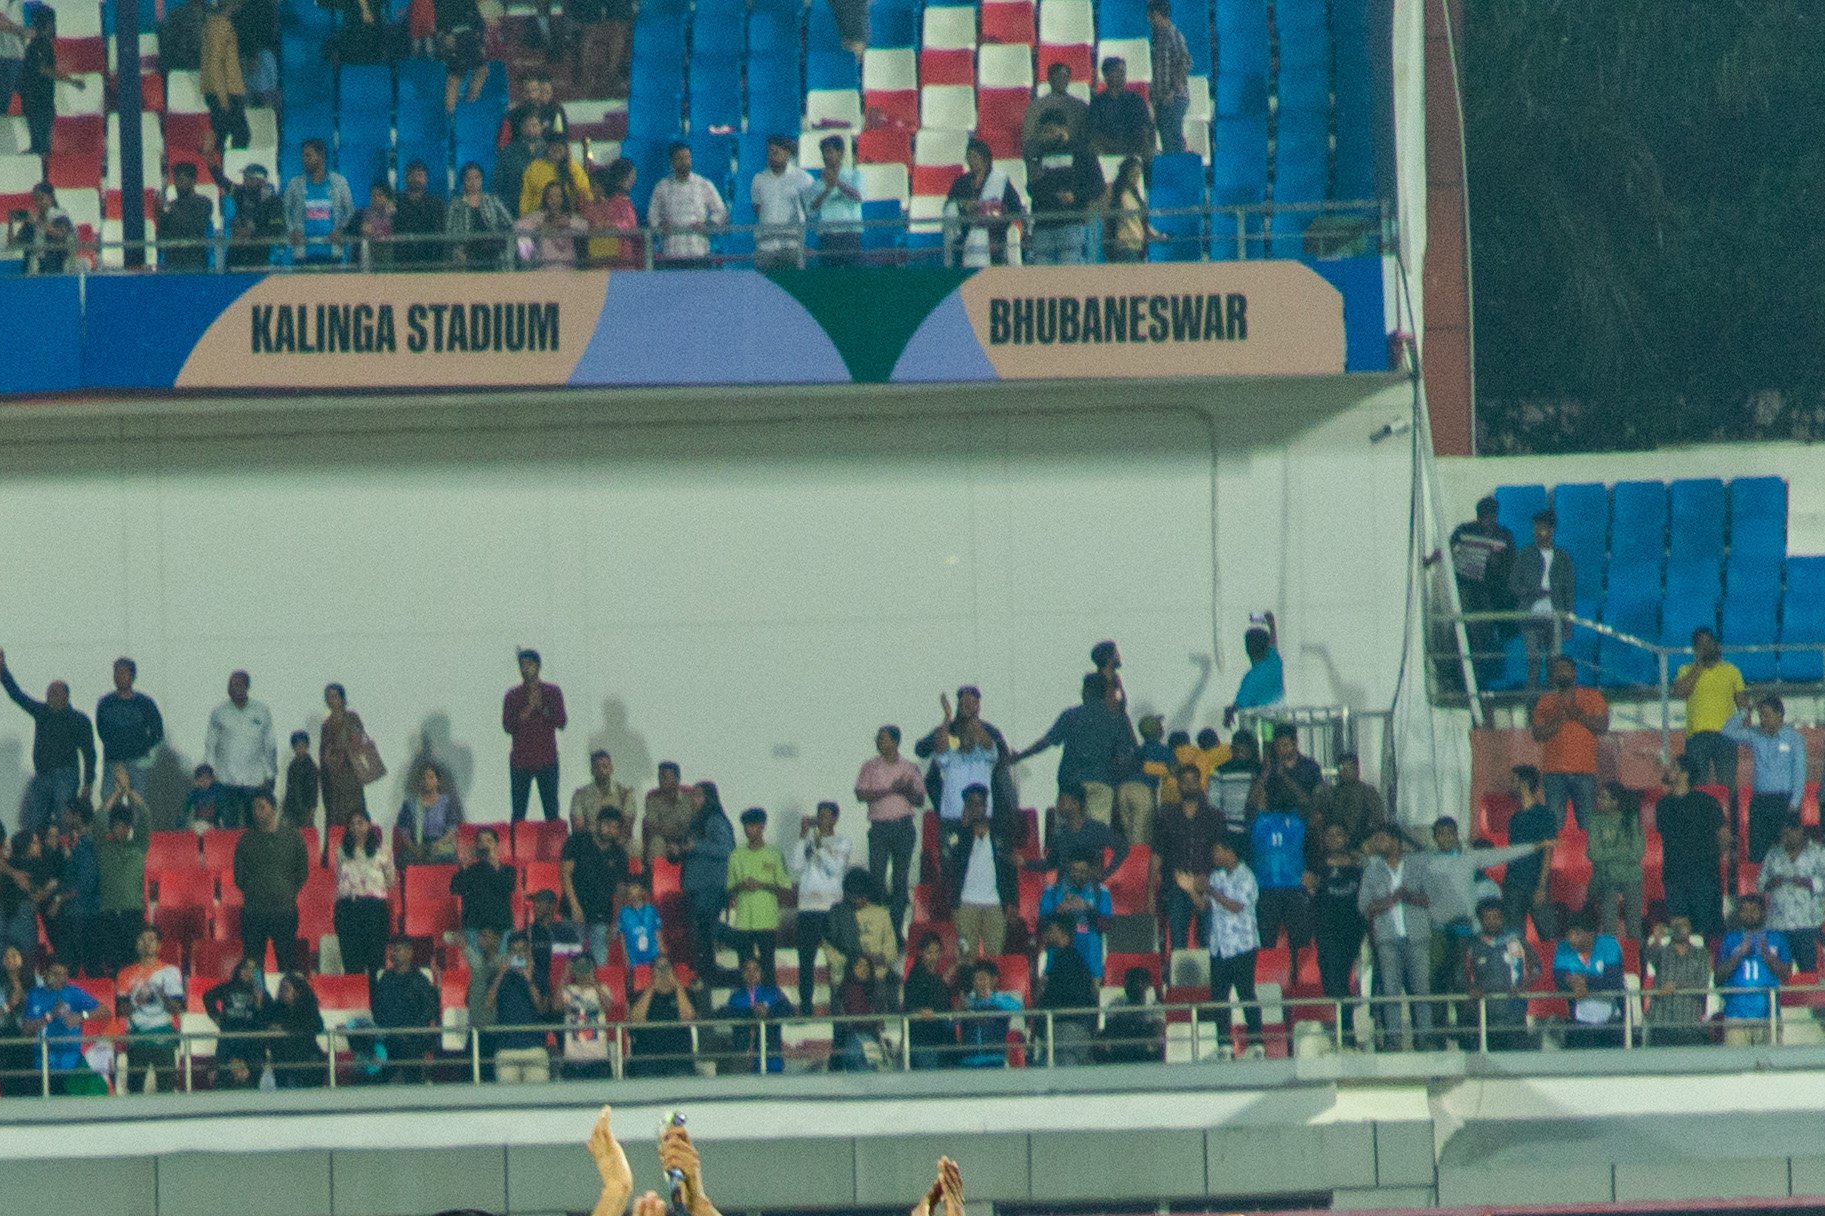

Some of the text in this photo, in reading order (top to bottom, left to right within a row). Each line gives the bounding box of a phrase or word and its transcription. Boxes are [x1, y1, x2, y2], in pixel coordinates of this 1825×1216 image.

[251, 302, 560, 354] KALINGA STADIUM
[989, 292, 1248, 346] BHUBANESWAR
